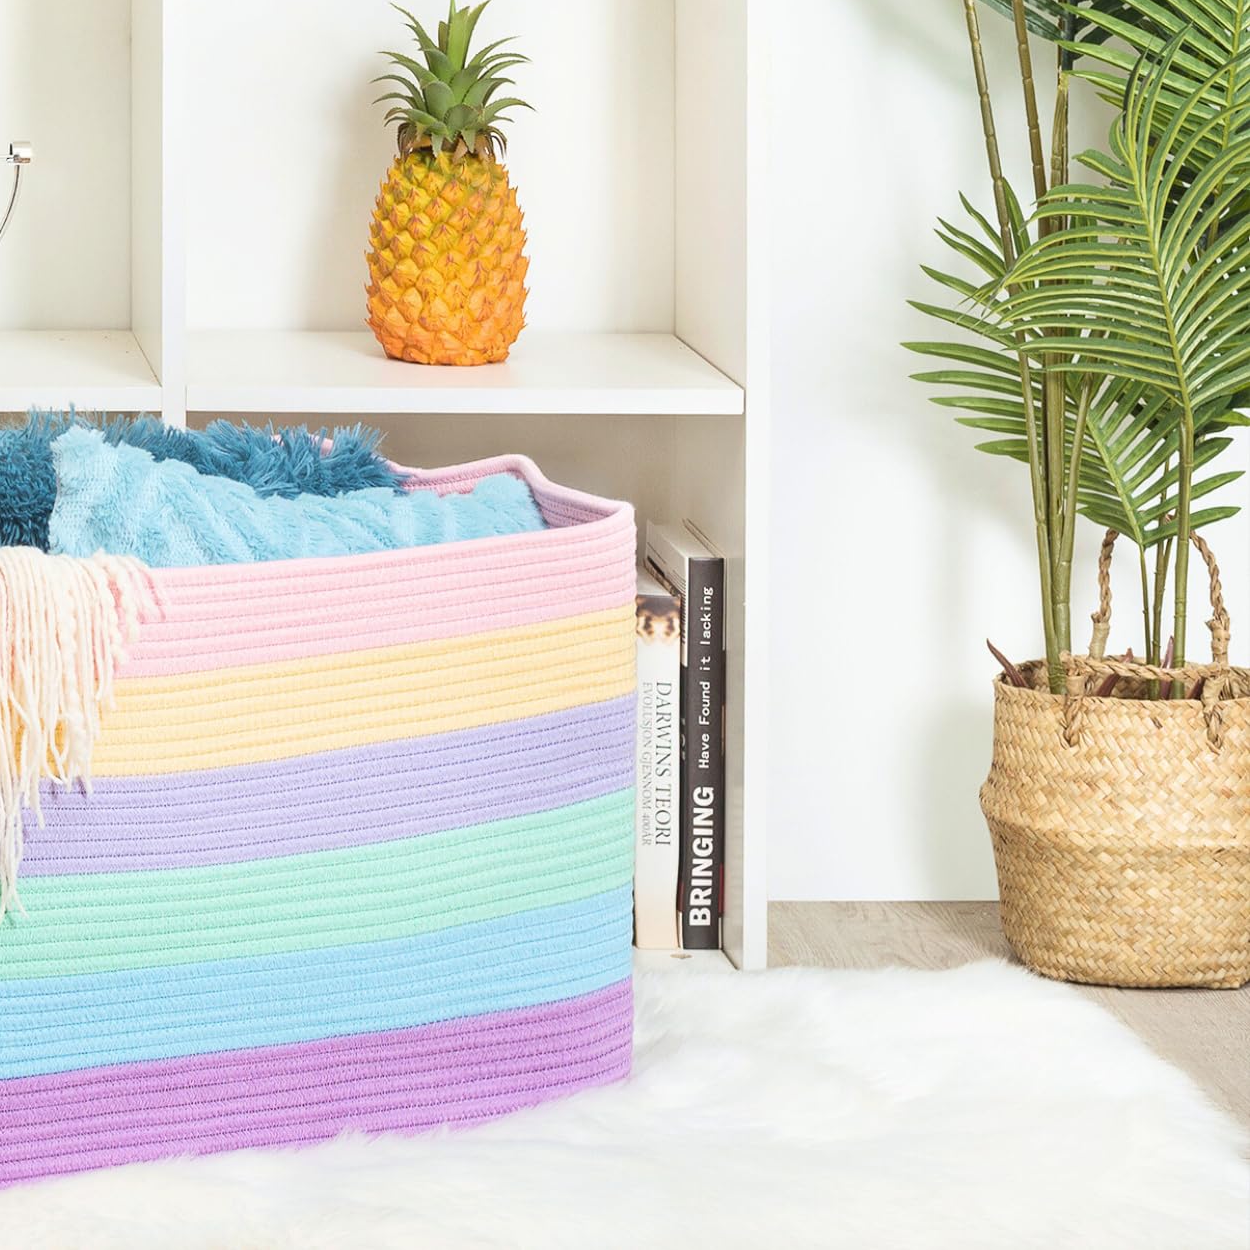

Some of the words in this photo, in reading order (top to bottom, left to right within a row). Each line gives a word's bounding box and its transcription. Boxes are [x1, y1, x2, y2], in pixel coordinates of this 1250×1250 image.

[700, 586, 713, 645] lacking
[699, 656, 711, 671] it
[655, 681, 672, 777] DARWINS
[699, 681, 711, 725] Found
[698, 733, 710, 769] Have
[655, 784, 672, 846] TEORI
[689, 786, 714, 927] BRINGING
